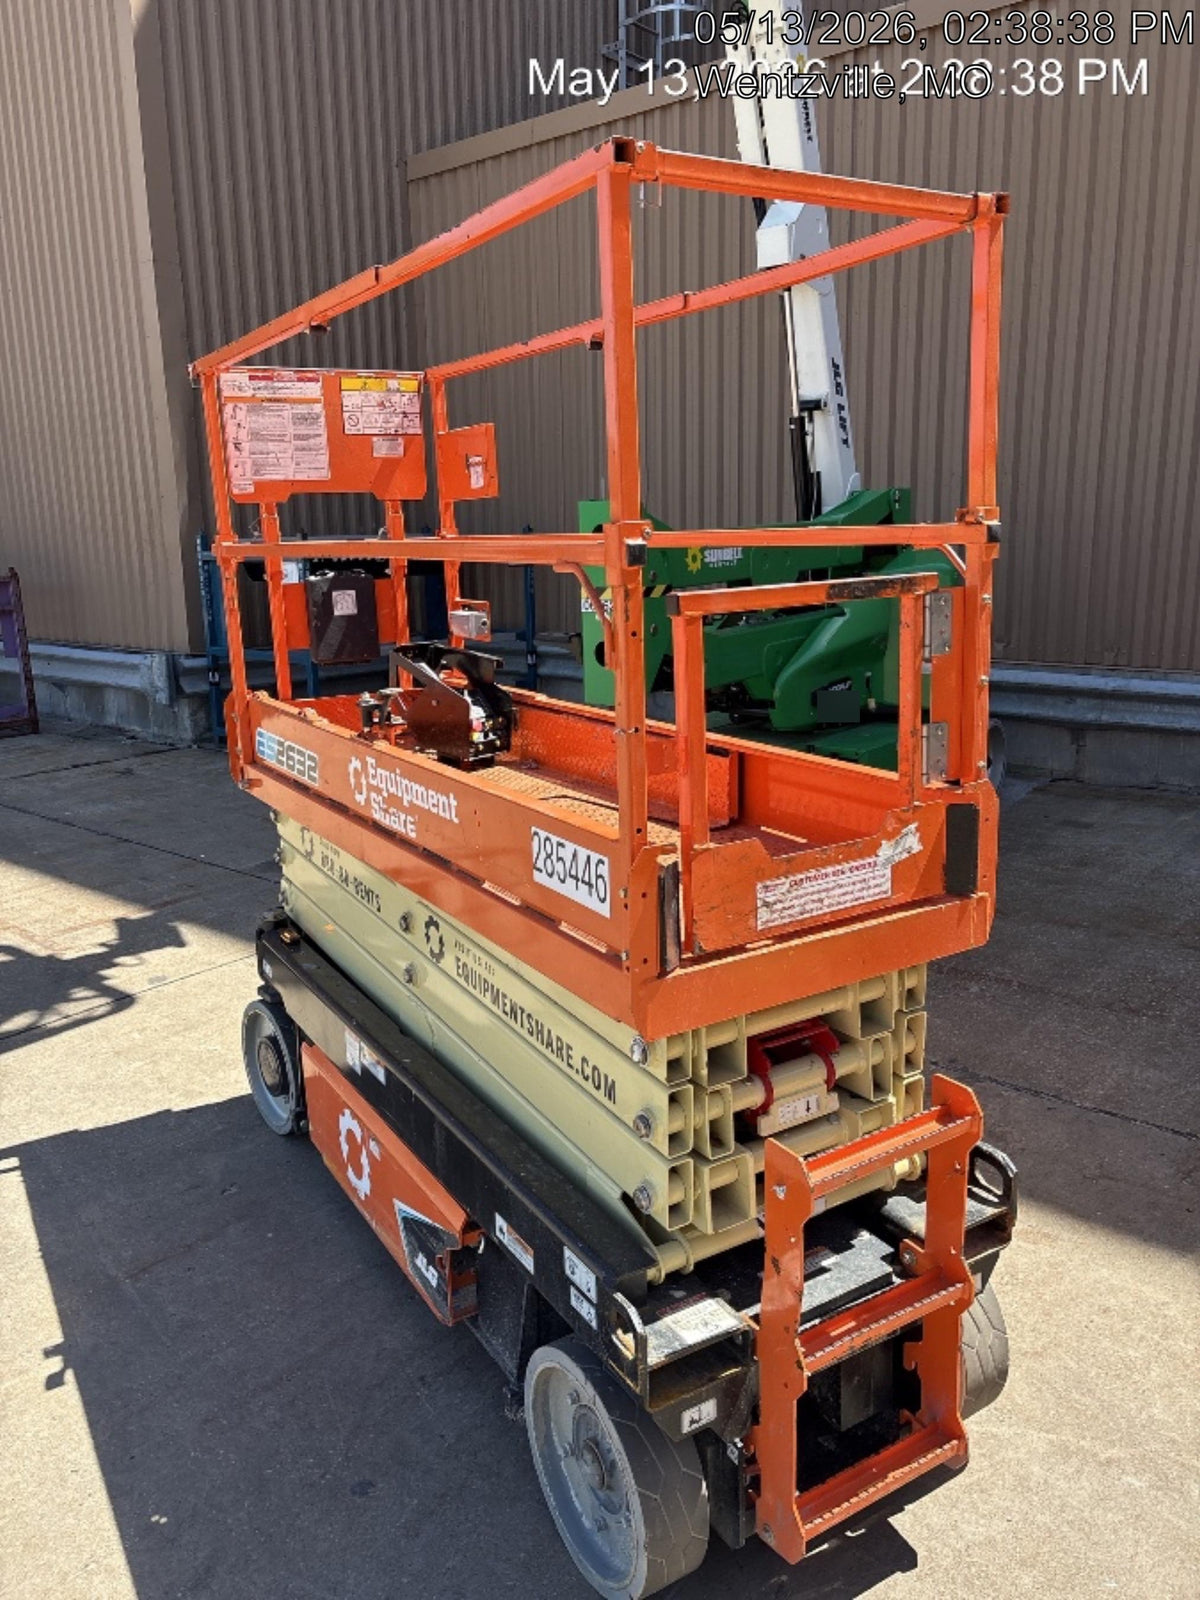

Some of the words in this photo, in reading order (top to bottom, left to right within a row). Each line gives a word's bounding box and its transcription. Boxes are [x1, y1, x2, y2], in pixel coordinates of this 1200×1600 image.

[366, 755, 460, 824] Equipment
[532, 830, 608, 904] 285446
[455, 955, 616, 1105] EQUIPMENTSHARE.COM
